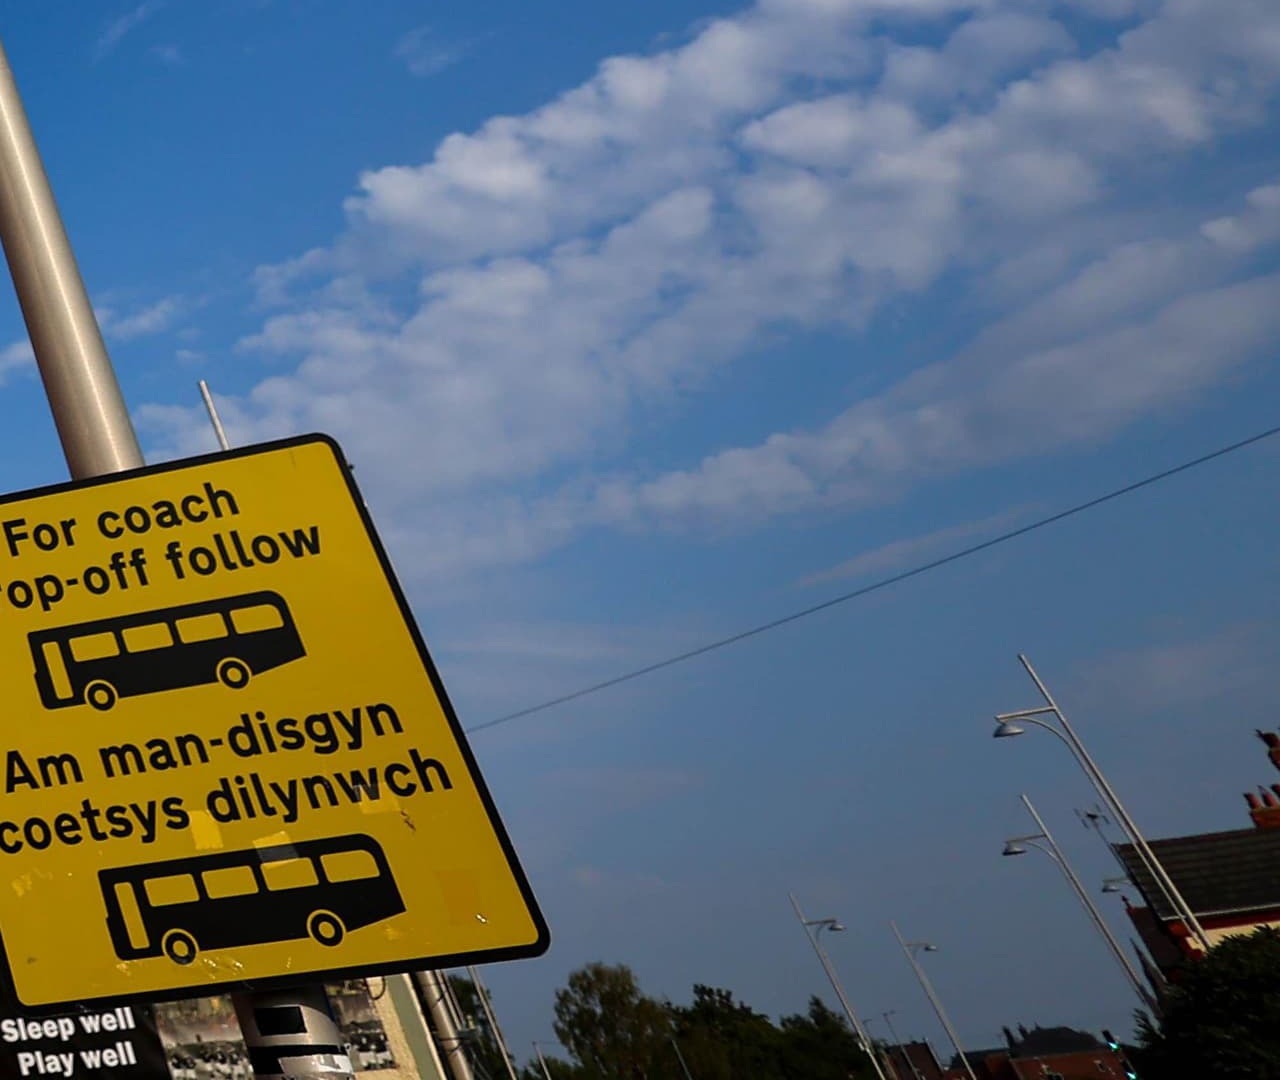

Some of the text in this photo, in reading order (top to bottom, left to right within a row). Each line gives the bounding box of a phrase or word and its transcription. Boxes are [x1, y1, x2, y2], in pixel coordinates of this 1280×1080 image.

[1, 481, 240, 557] For coach
[165, 524, 322, 580] follow
[3, 700, 404, 794] Am man-disgyn
[206, 747, 454, 824] dilynwch
[0, 1006, 136, 1042] Sleep well
[17, 1041, 137, 1077] Play well
